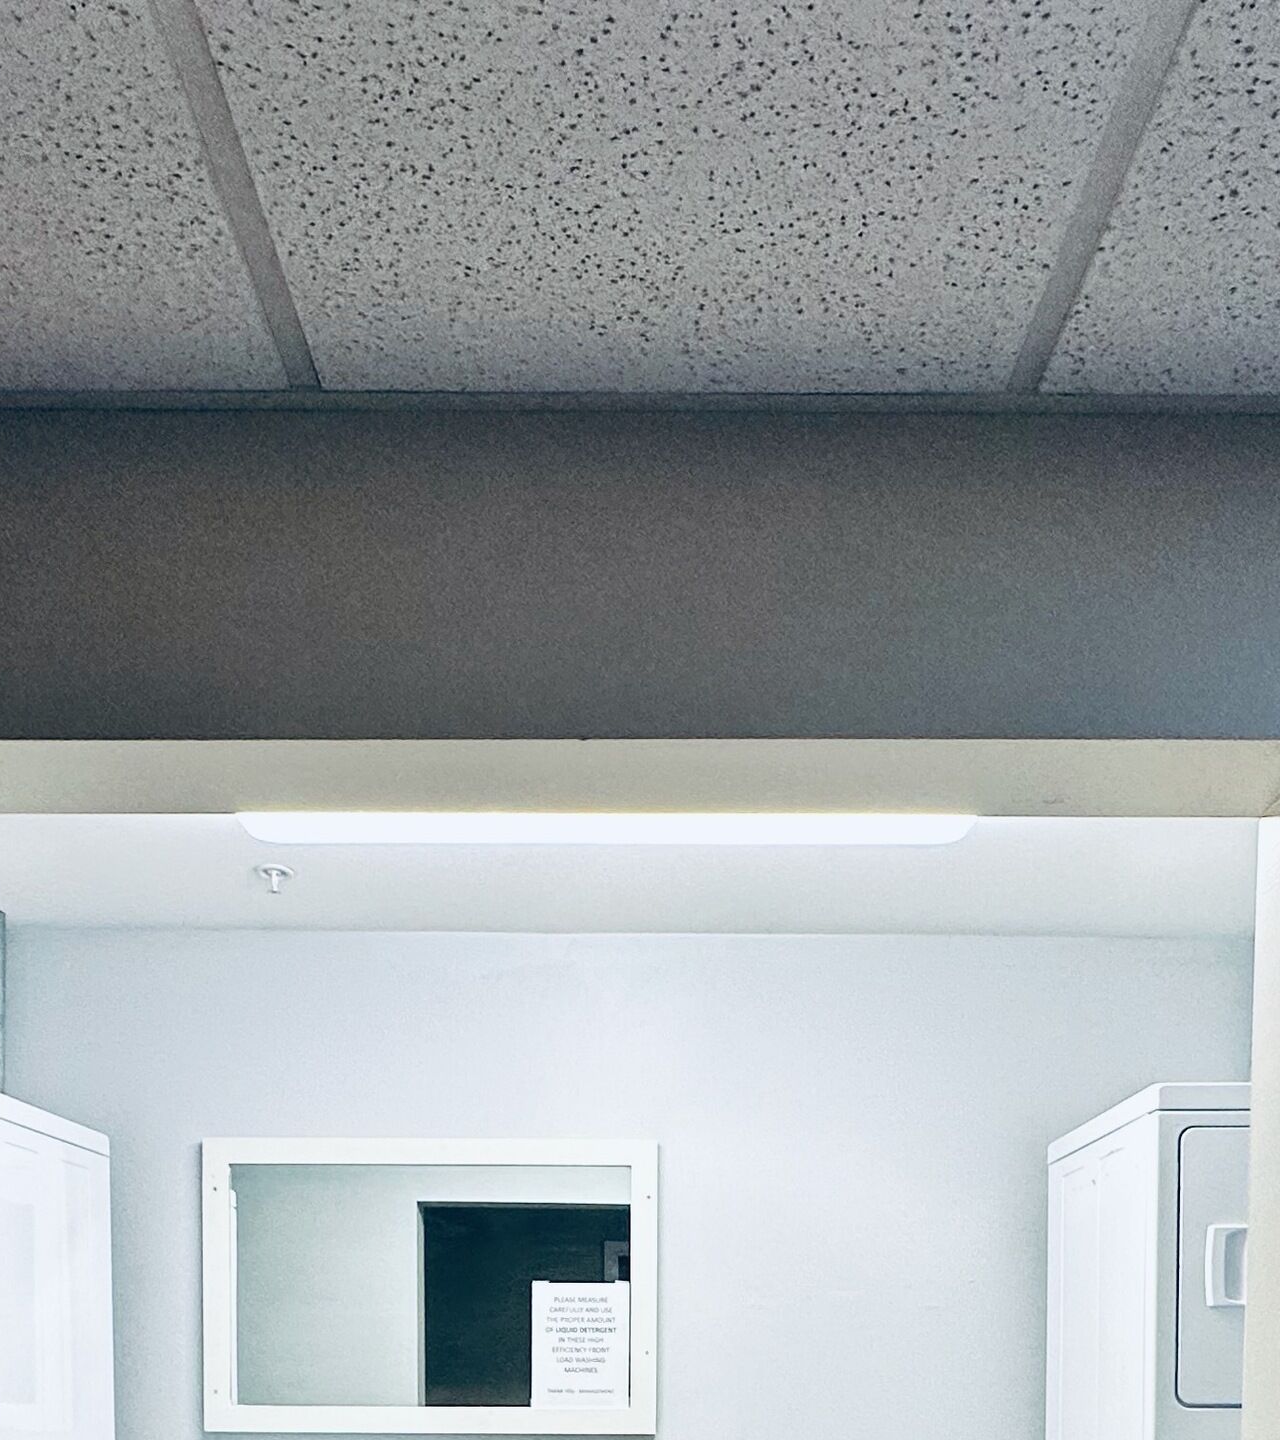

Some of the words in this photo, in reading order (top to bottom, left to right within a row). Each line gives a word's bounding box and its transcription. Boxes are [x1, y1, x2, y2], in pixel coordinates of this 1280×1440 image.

[553, 1296, 577, 1304] PLEASE
[577, 1296, 609, 1304] MEASURE
[584, 1306, 600, 1314] AND
[600, 1306, 613, 1314] USE
[586, 1316, 616, 1324] AMOUNT
[564, 1366, 598, 1374] MACHINES
